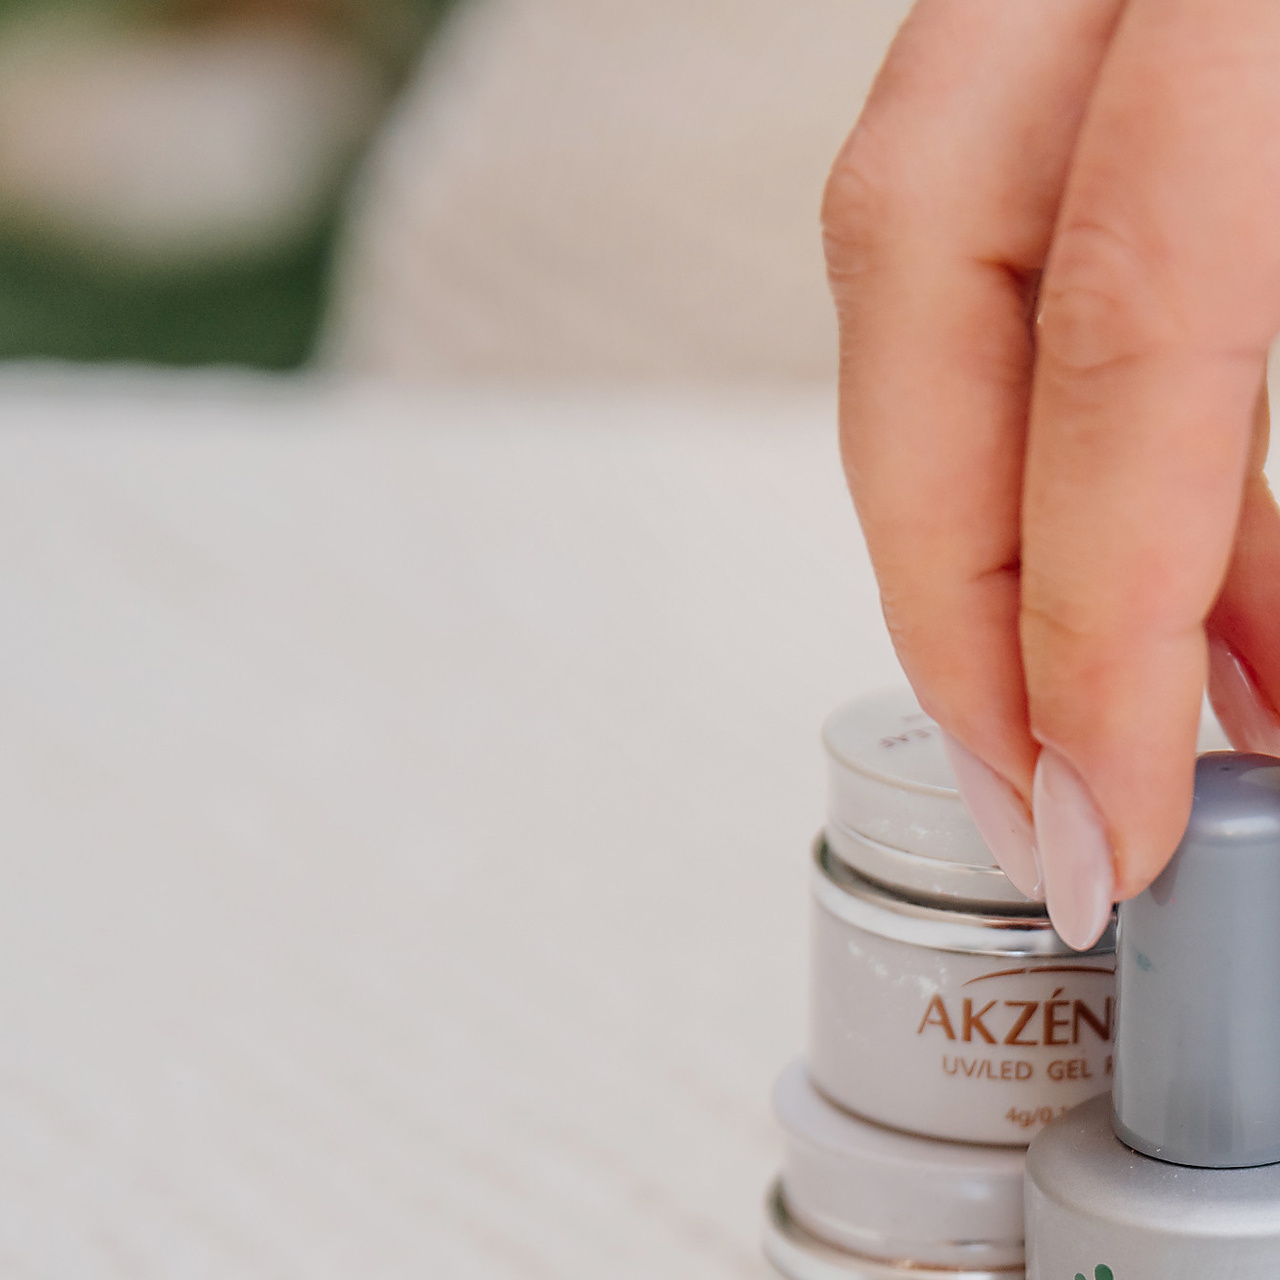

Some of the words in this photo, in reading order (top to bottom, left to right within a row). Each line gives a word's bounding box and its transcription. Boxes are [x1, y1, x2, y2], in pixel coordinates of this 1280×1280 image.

[917, 987, 1115, 1046] AKZÉN
[943, 1055, 1033, 1080] UV/LED
[1047, 1058, 1092, 1081] GEL
